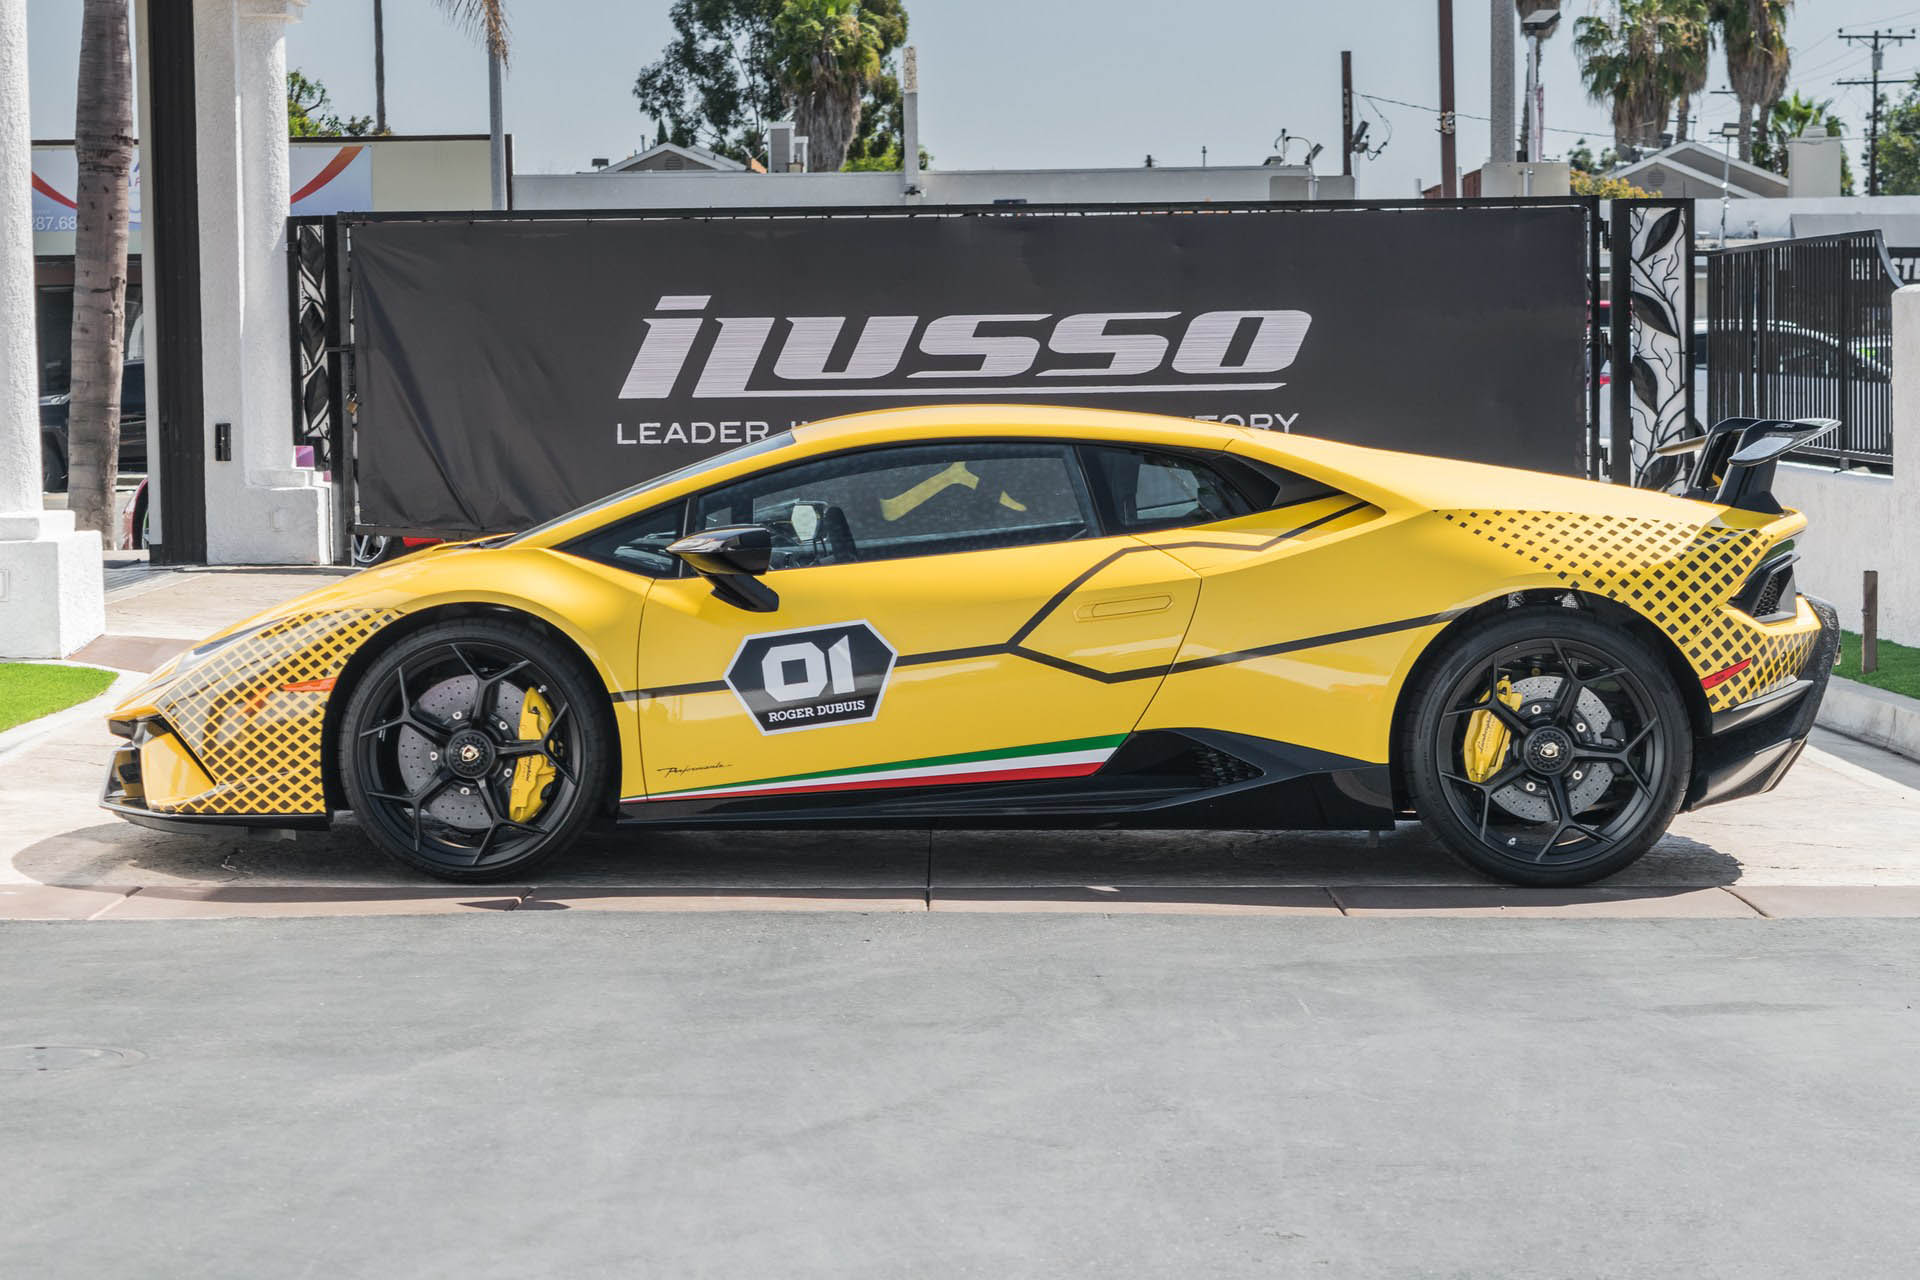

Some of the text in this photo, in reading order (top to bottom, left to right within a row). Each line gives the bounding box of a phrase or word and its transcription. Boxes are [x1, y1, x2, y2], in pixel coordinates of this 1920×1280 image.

[616, 421, 769, 445] LEADER
[761, 634, 856, 703] 01
[768, 699, 866, 723] ROGER DUBUIS
